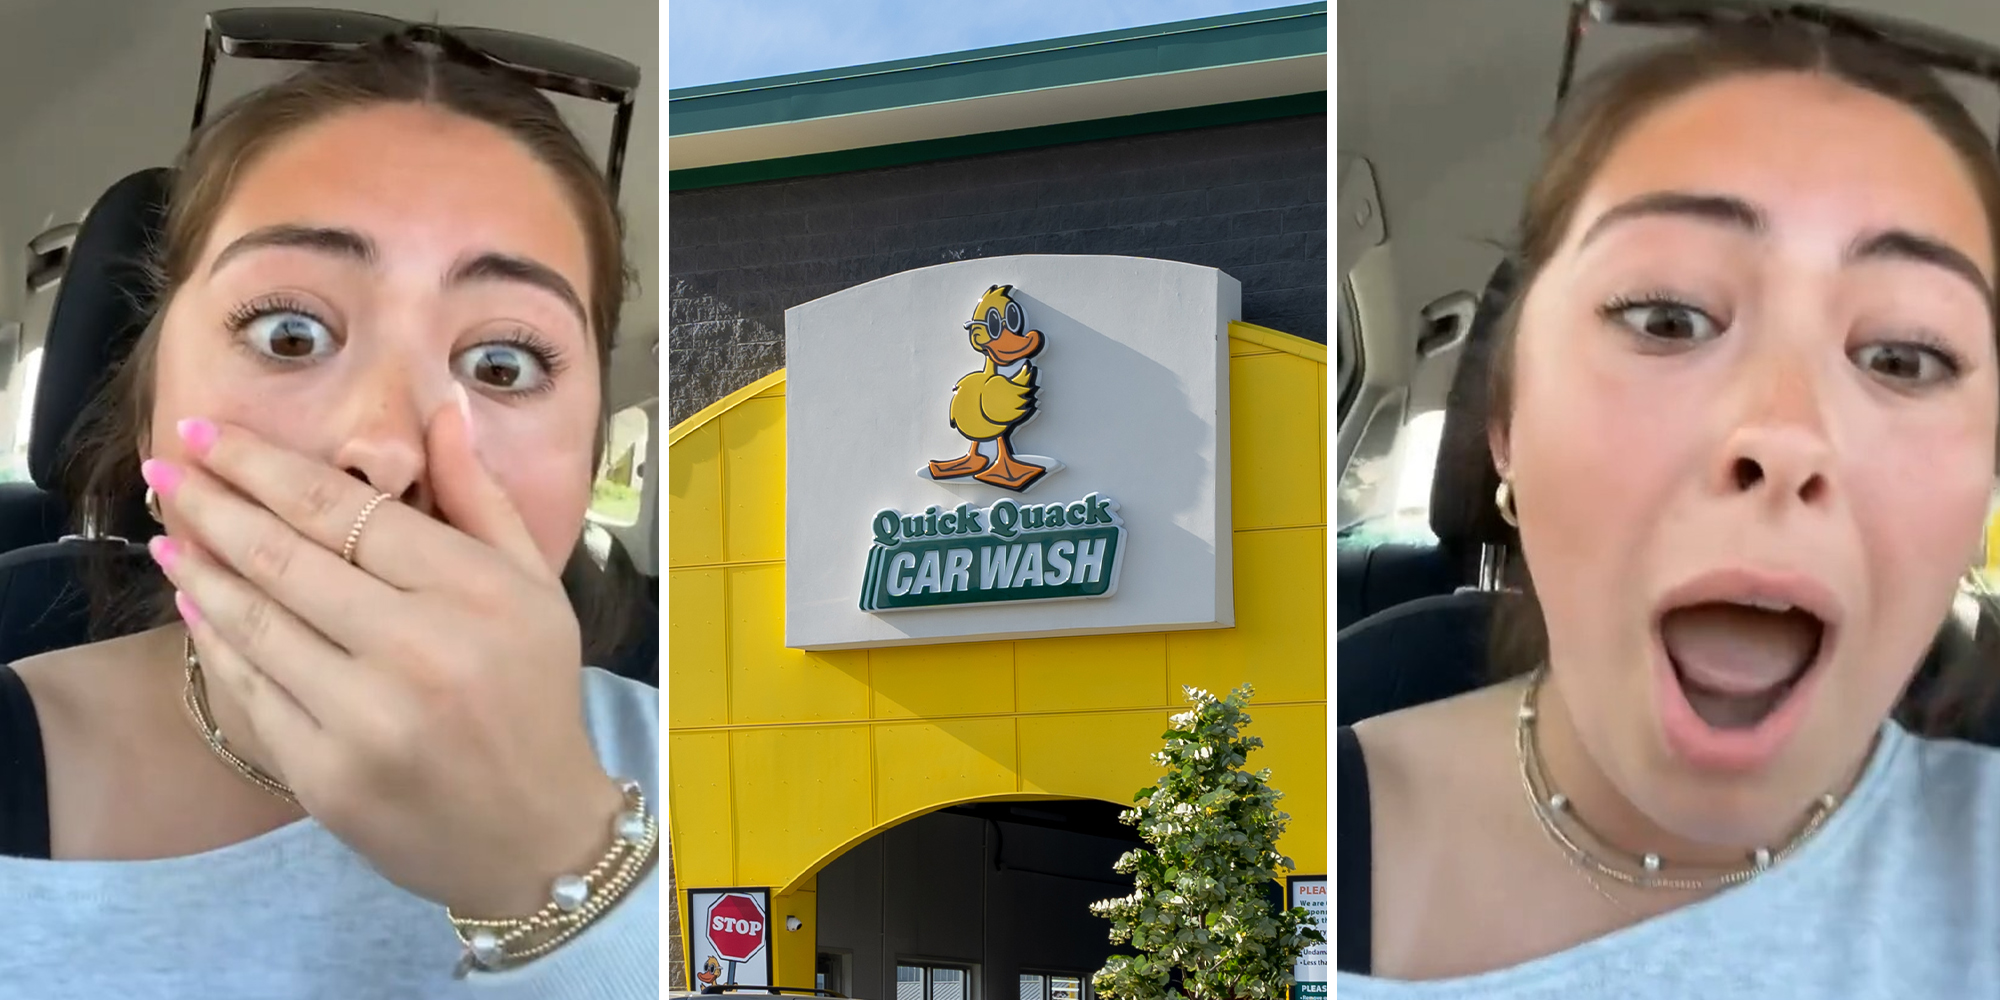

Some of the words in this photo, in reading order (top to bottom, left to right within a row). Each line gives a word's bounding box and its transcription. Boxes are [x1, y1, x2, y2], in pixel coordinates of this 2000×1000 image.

[873, 504, 982, 546] Quick
[989, 495, 1113, 537] Quack
[886, 548, 973, 597] CAR
[980, 538, 1107, 591] WASH
[1299, 886, 1327, 895] PLEA
[712, 916, 762, 936] STOP
